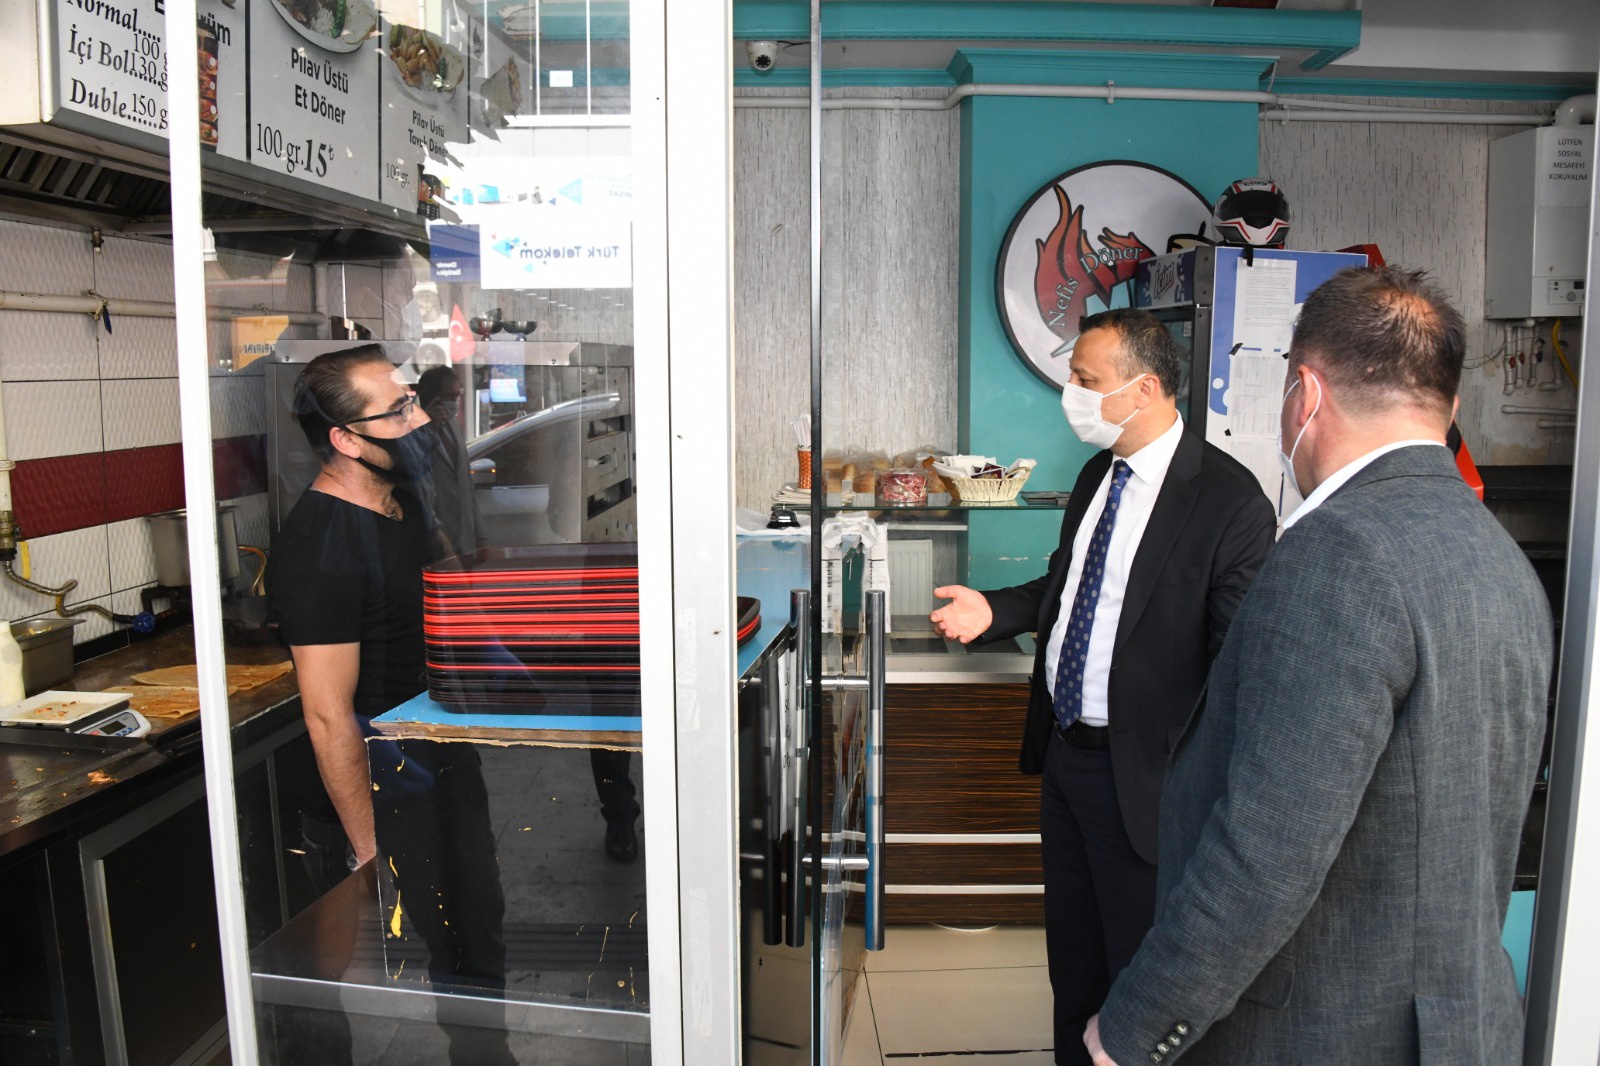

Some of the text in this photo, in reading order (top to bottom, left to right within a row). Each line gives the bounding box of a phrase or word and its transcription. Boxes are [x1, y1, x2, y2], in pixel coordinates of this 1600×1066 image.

[323, 60, 349, 94] Üstü
[131, 93, 156, 118] 150
[295, 84, 346, 125] Et Döner
[412, 109, 445, 138] Pilav Üstü
[256, 123, 283, 158] 100
[1557, 138, 1583, 146] LÜTFEN
[1557, 150, 1582, 158] SOSYAL
[1548, 173, 1588, 181] KORUYALIM
[1048, 245, 1143, 327] Nefis Döner
